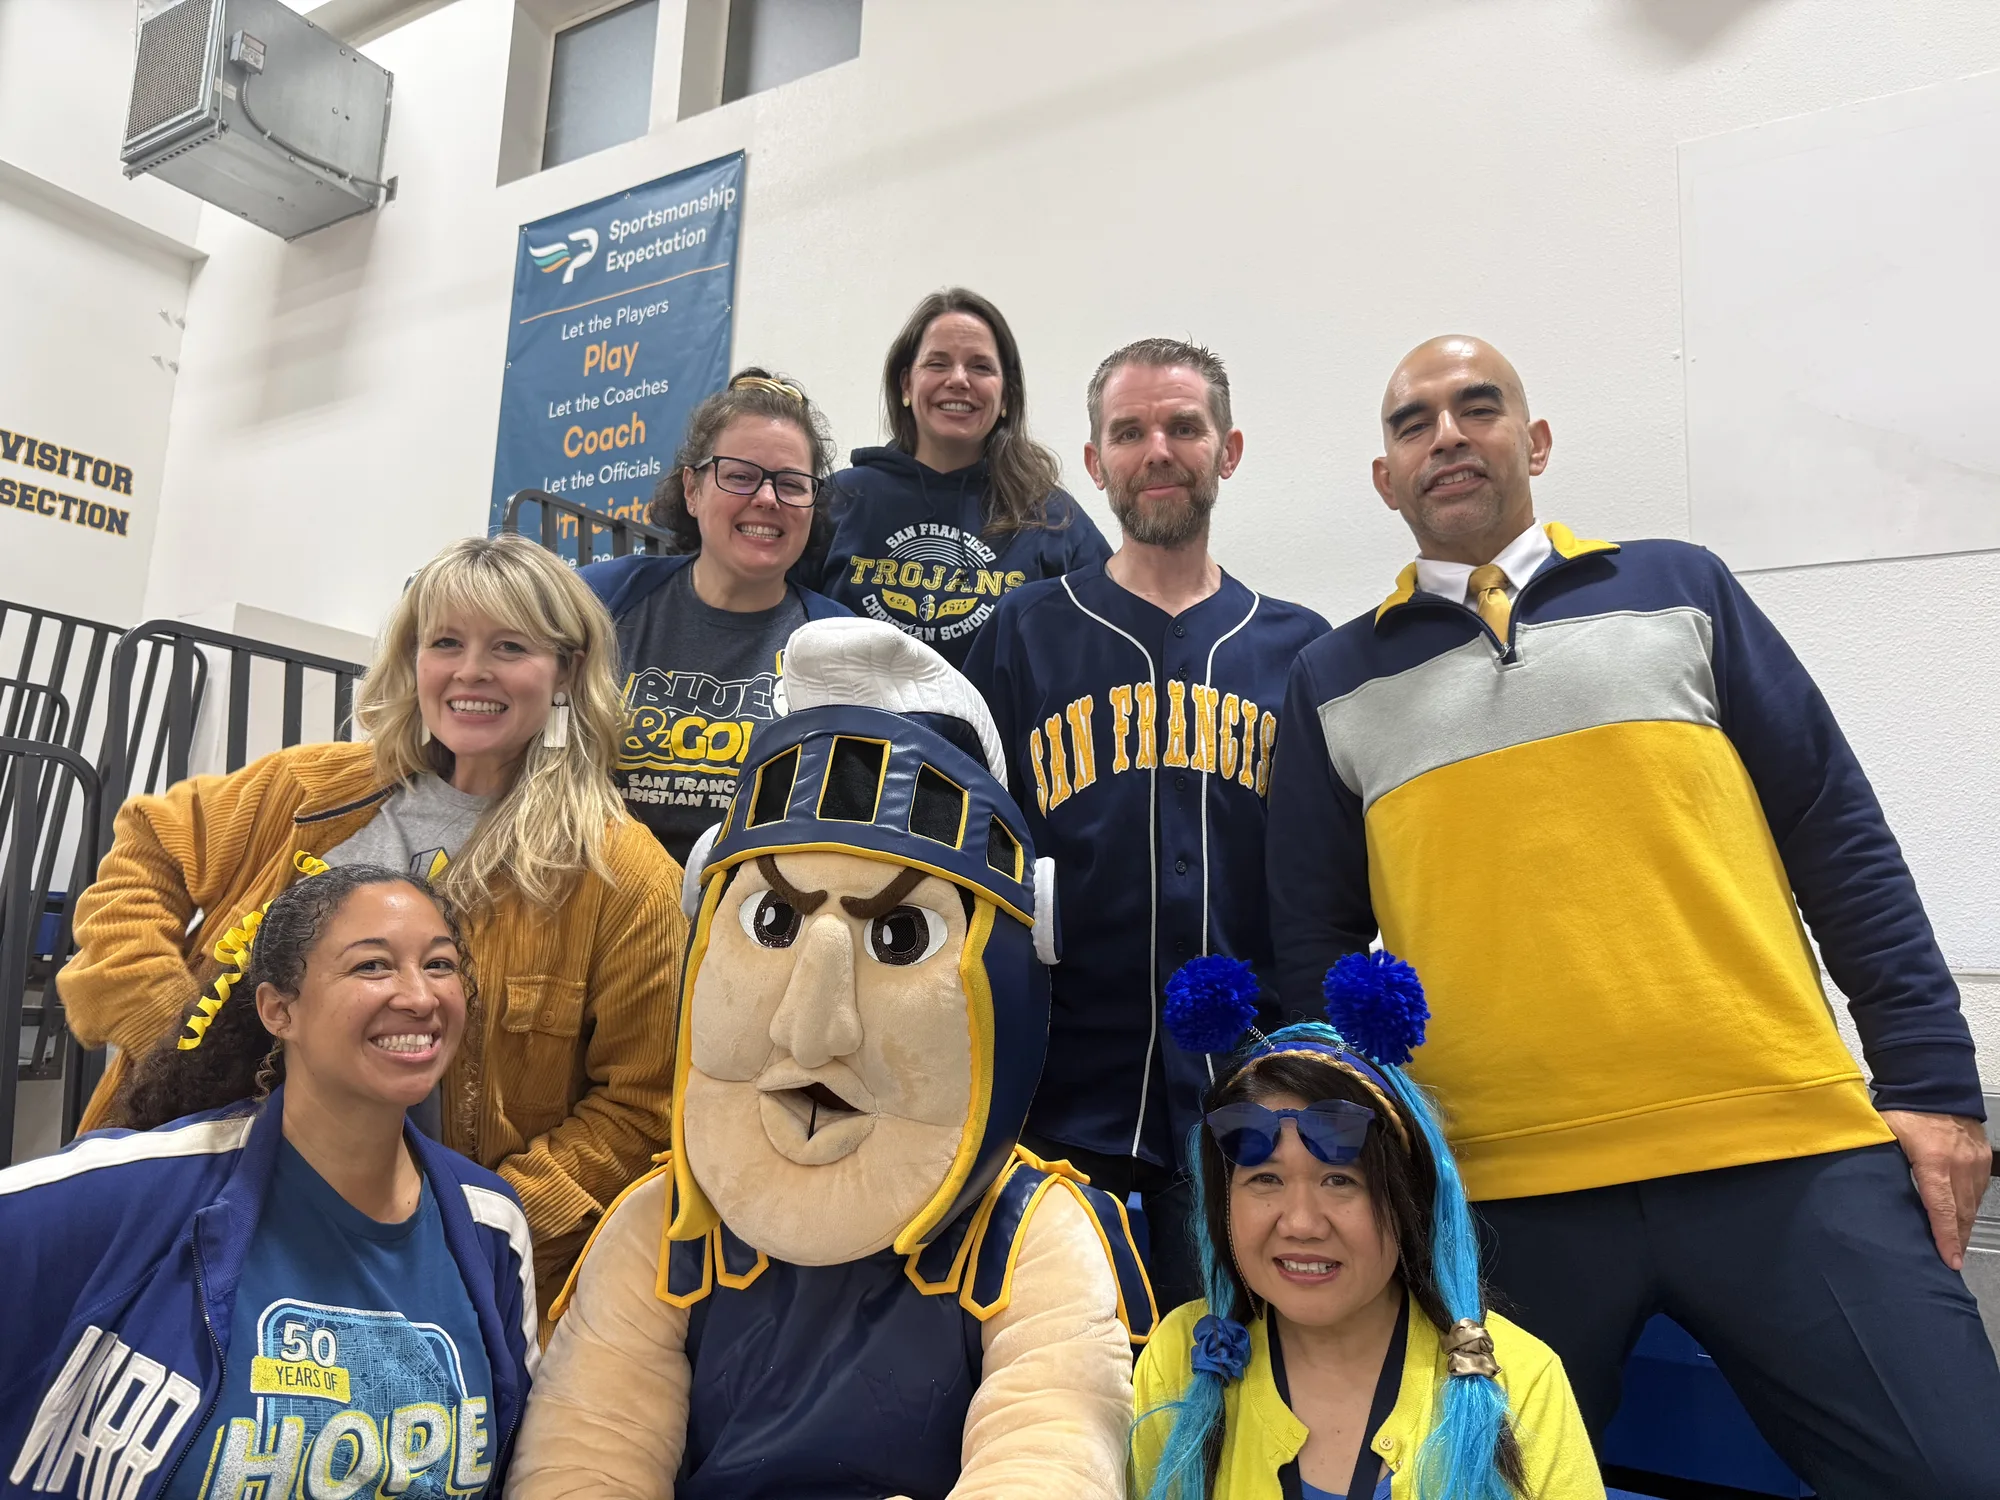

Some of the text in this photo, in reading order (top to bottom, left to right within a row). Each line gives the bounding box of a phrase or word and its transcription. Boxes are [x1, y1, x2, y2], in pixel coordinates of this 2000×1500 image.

[608, 183, 736, 244] Sportsmanship
[605, 227, 707, 273] Expectation
[561, 300, 669, 341] Let the Players
[583, 340, 640, 377] Play
[548, 378, 669, 419] Let the Coaches
[563, 411, 646, 459] Coach
[0, 428, 134, 496] VISITOR
[543, 455, 661, 494] Let the Officials
[0, 477, 130, 538] SECTION
[885, 525, 917, 549] SAN
[850, 555, 1026, 596] TROJANS
[940, 602, 995, 641] SCHOOL
[625, 667, 775, 720] BLUE
[1030, 679, 1277, 819] SAN FRANCIS
[618, 786, 704, 808] HRISTIAN
[628, 773, 737, 794] SAN FRANC
[280, 1319, 337, 1368] 50
[275, 1365, 338, 1392] YEARS OF
[200, 1396, 493, 1500] HOPE
